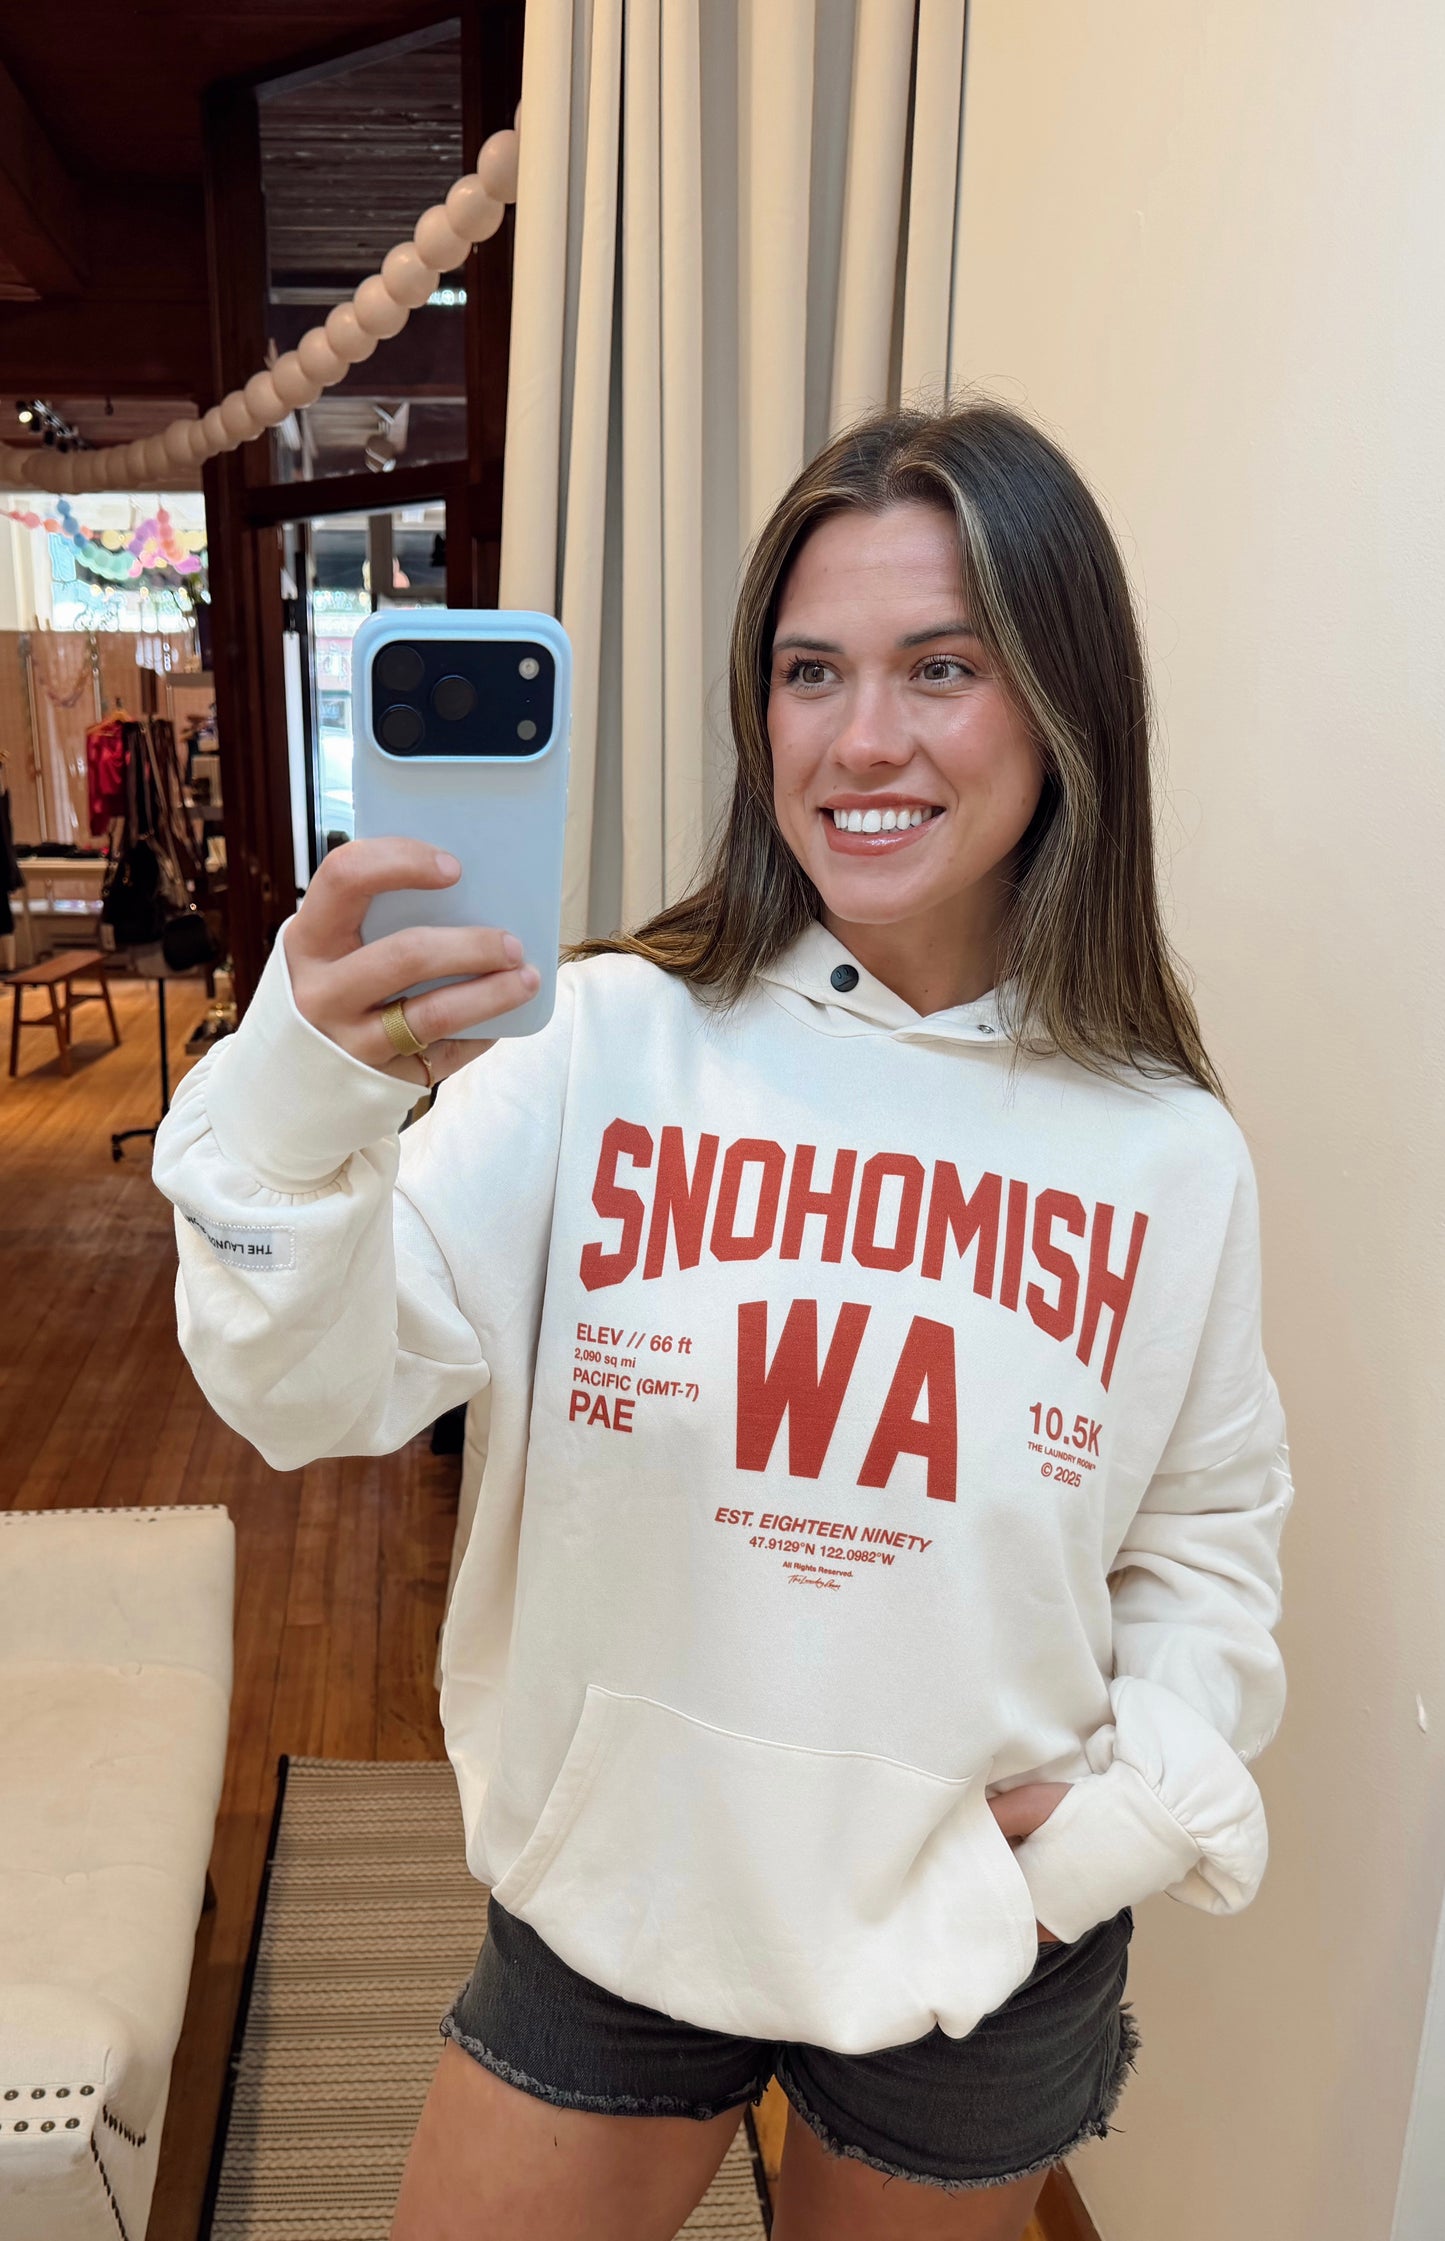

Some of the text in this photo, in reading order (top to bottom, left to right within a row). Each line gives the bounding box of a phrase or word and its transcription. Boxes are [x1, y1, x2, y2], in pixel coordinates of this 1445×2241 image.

[208, 1236, 273, 1255] THE LAUND
[579, 1118, 1149, 1393] SNOHOMISH
[576, 1322, 693, 1354] ELEV // 66 ft
[574, 1347, 637, 1368] 2,090 sq mi
[572, 1367, 700, 1402] PACIFIC (GMT-7)
[736, 1298, 958, 1503] WA
[569, 1389, 636, 1433] PAE
[1029, 1402, 1103, 1457] 10.5K
[1027, 1441, 1043, 1453] THE
[1044, 1446, 1077, 1464] LAUNDRY
[1053, 1466, 1082, 1487] 2025
[714, 1506, 933, 1553] EST. EIGHTEEN NINETY
[748, 1536, 895, 1566] 47.9129°N 122.0982°W
[782, 1560, 793, 1569] All
[793, 1561, 817, 1573] Rights
